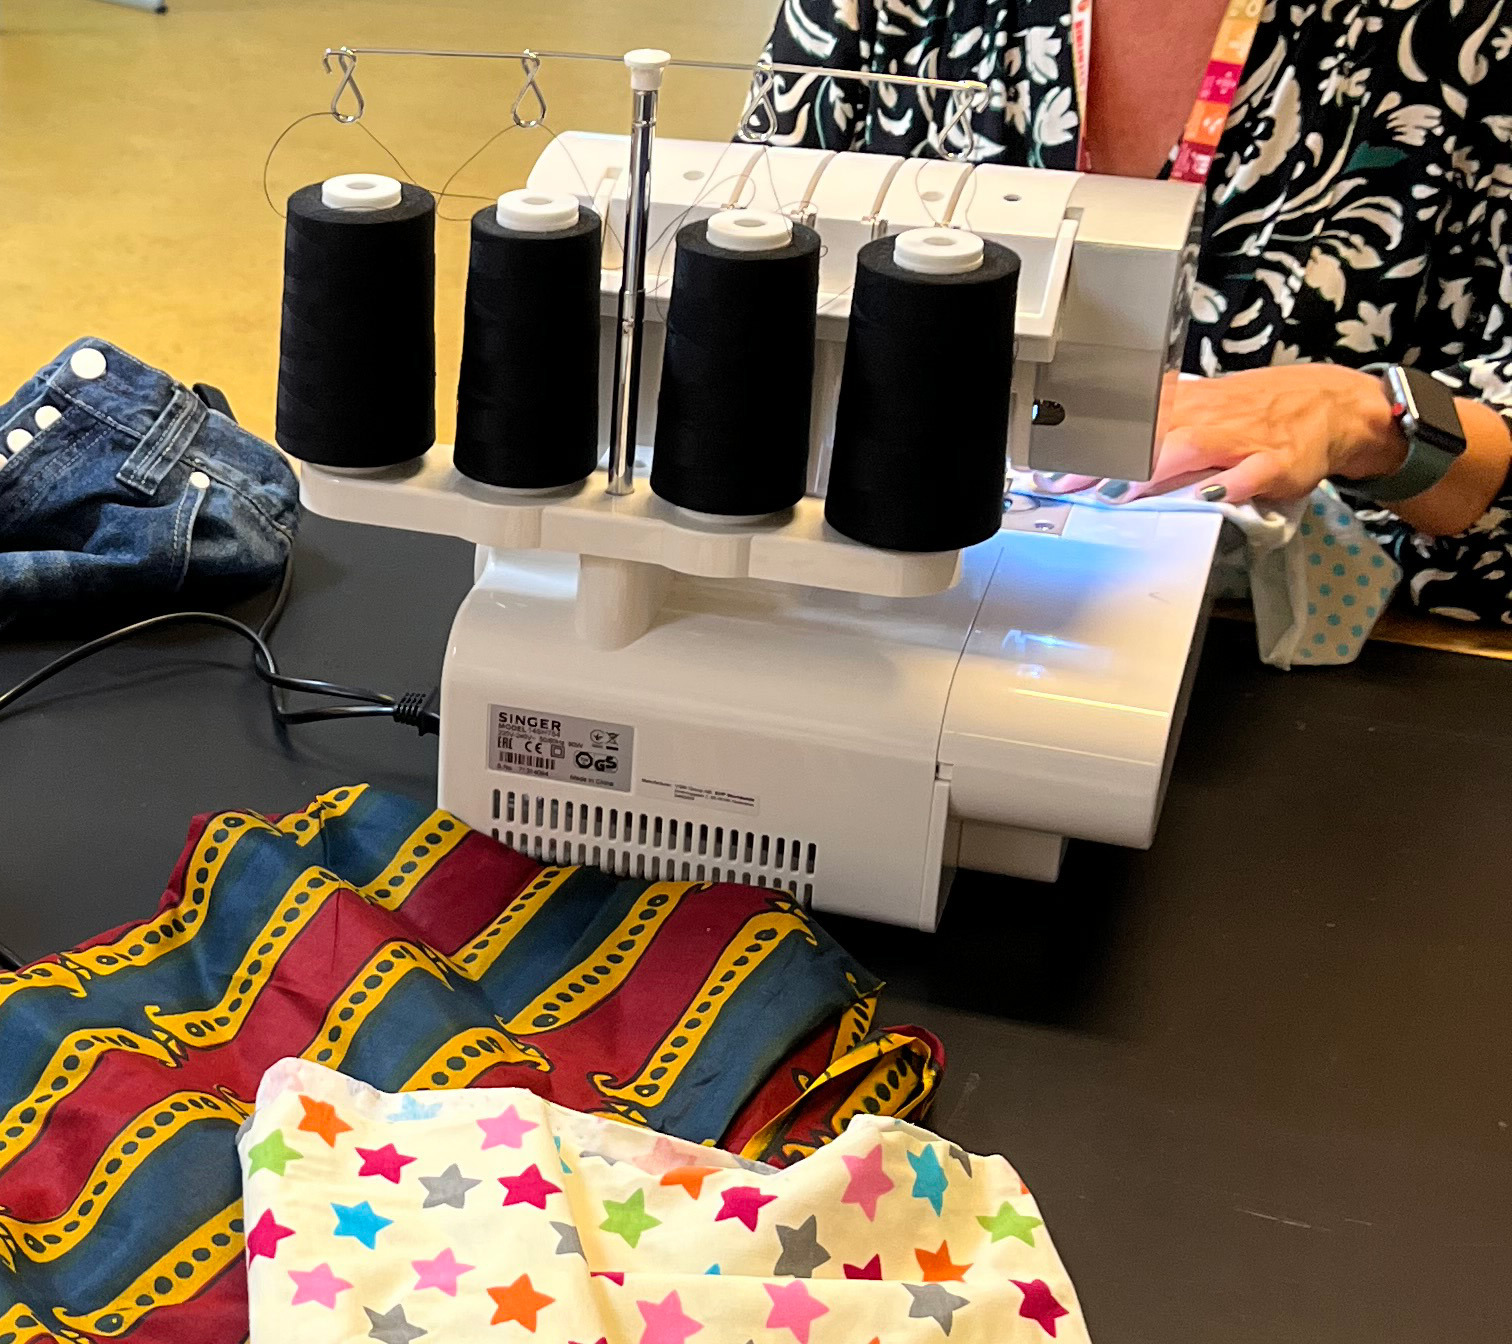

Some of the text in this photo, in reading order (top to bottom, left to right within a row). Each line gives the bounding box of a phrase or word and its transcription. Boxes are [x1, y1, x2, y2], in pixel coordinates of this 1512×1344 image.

[498, 711, 562, 732] SINGER
[498, 723, 527, 734] MODEL
[594, 755, 618, 772] GS
[570, 774, 587, 783] Made
[596, 777, 614, 787] China
